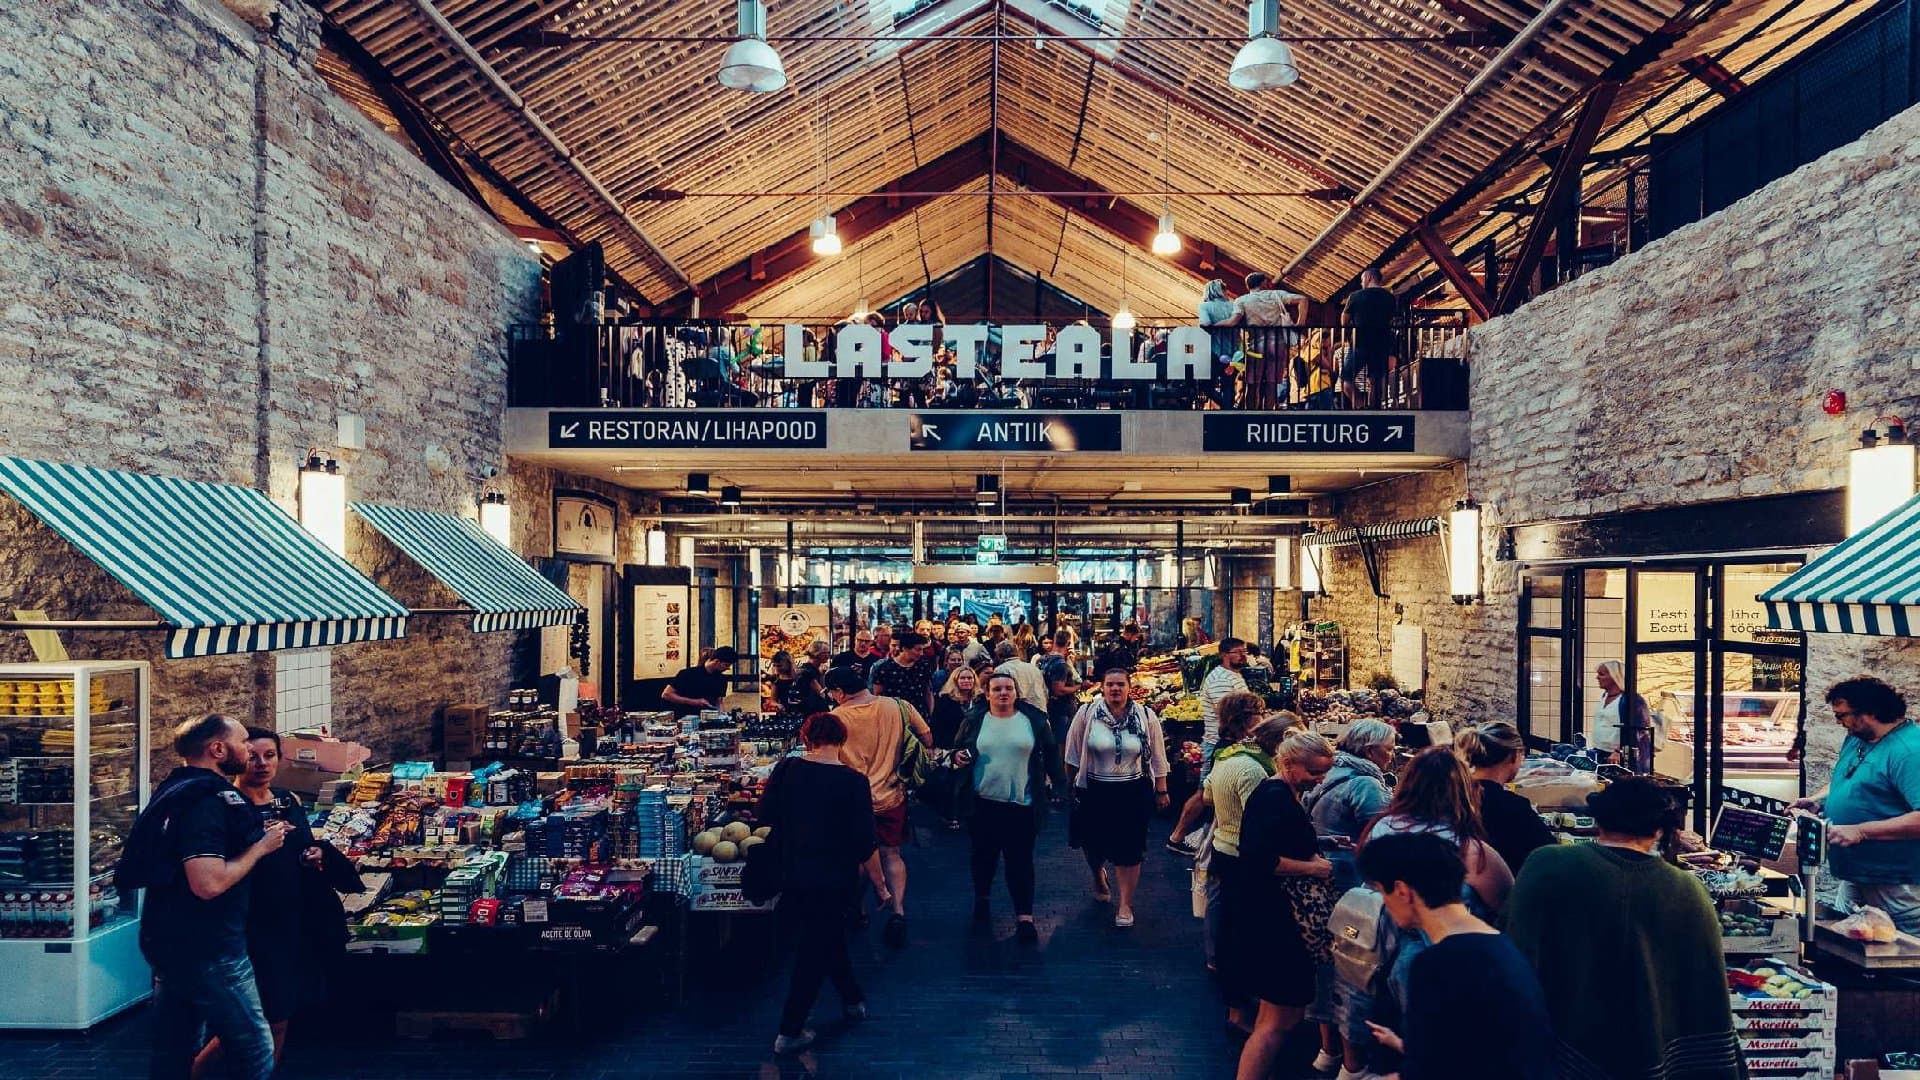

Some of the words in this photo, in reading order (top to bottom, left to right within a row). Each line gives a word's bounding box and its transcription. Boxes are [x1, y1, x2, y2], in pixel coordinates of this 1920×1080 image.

[784, 324, 1211, 379] LASTEALA
[588, 420, 817, 442] RESTORAN/LIHAPOOD
[977, 422, 1053, 443] ANTIIK
[1247, 423, 1369, 443] RIIDETURG
[1748, 1000, 1801, 1010] Moretta
[1746, 1020, 1799, 1030] Moretta
[1746, 1039, 1798, 1049] Moretta
[1746, 1059, 1798, 1068] Moretta
